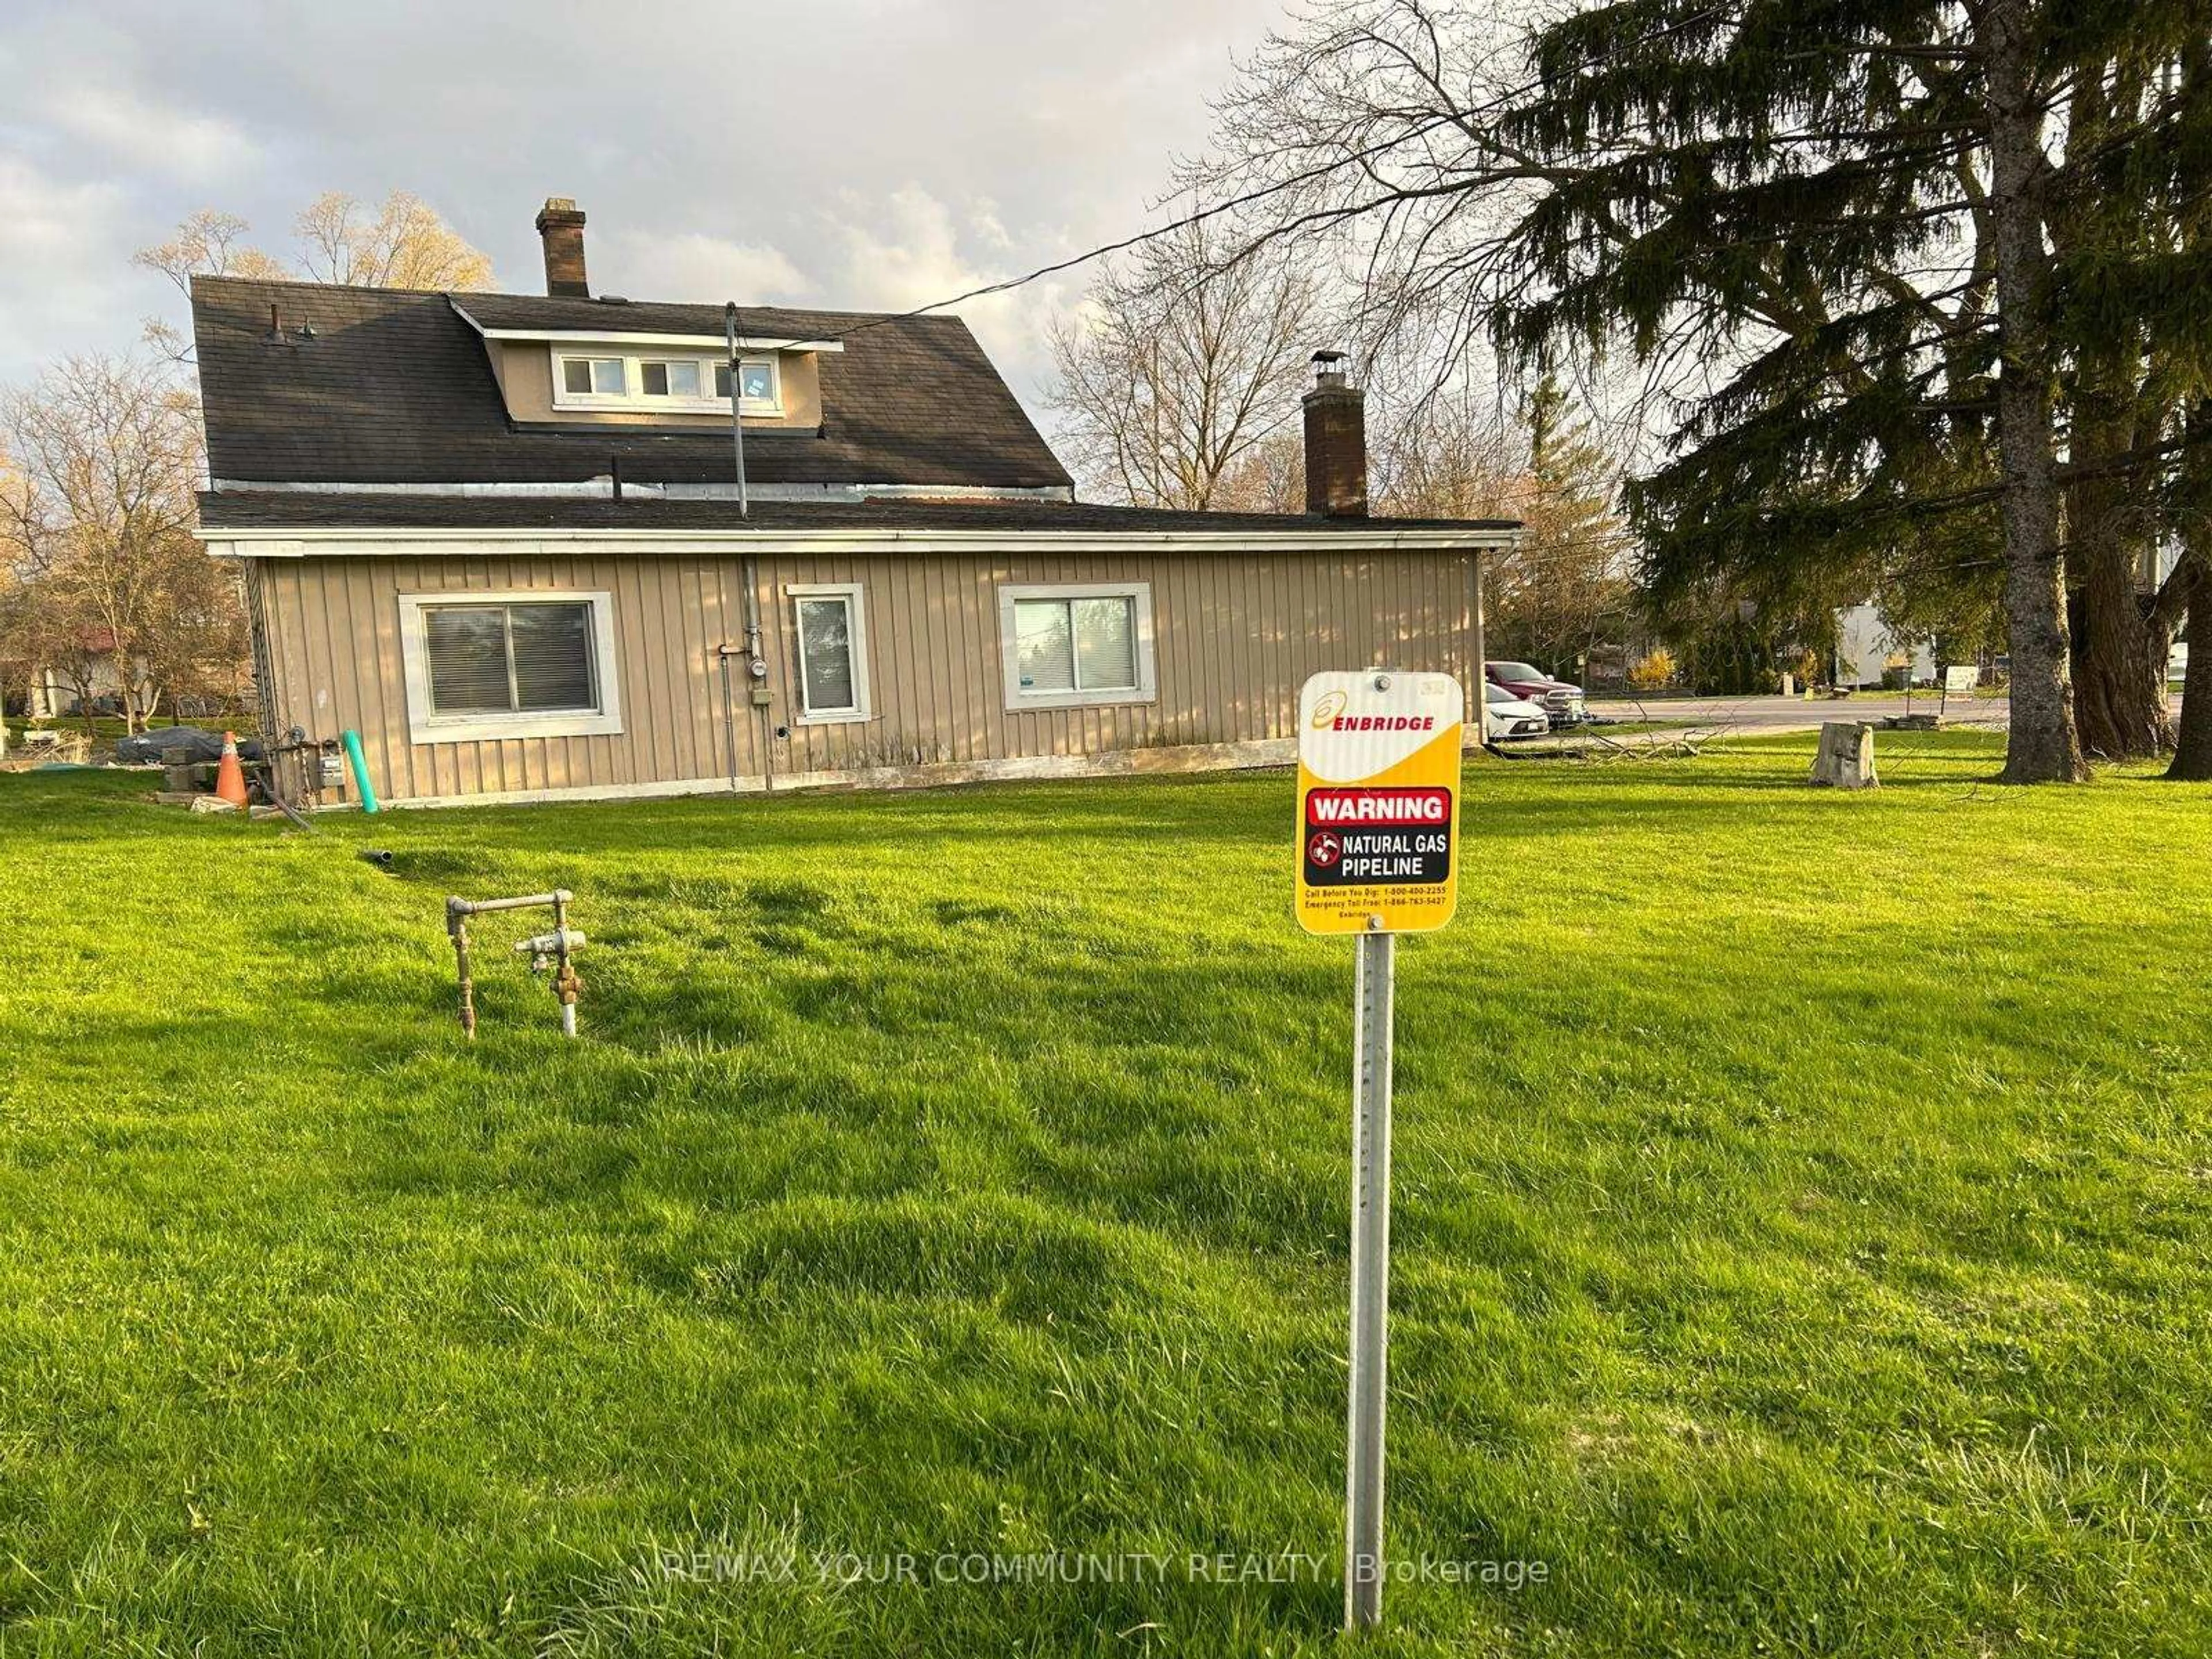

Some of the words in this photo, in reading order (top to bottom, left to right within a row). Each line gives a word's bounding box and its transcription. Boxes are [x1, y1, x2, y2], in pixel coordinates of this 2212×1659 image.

[1332, 717, 1434, 731] ENBRIDGE
[1314, 796, 1442, 820] WARNING
[1343, 835, 1411, 854] NATURAL
[1415, 834, 1446, 853] GAS
[1342, 857, 1423, 876] PIPELINE
[1305, 889, 1320, 898] Call
[1350, 888, 1363, 897] You
[1305, 900, 1344, 910] Emergency
